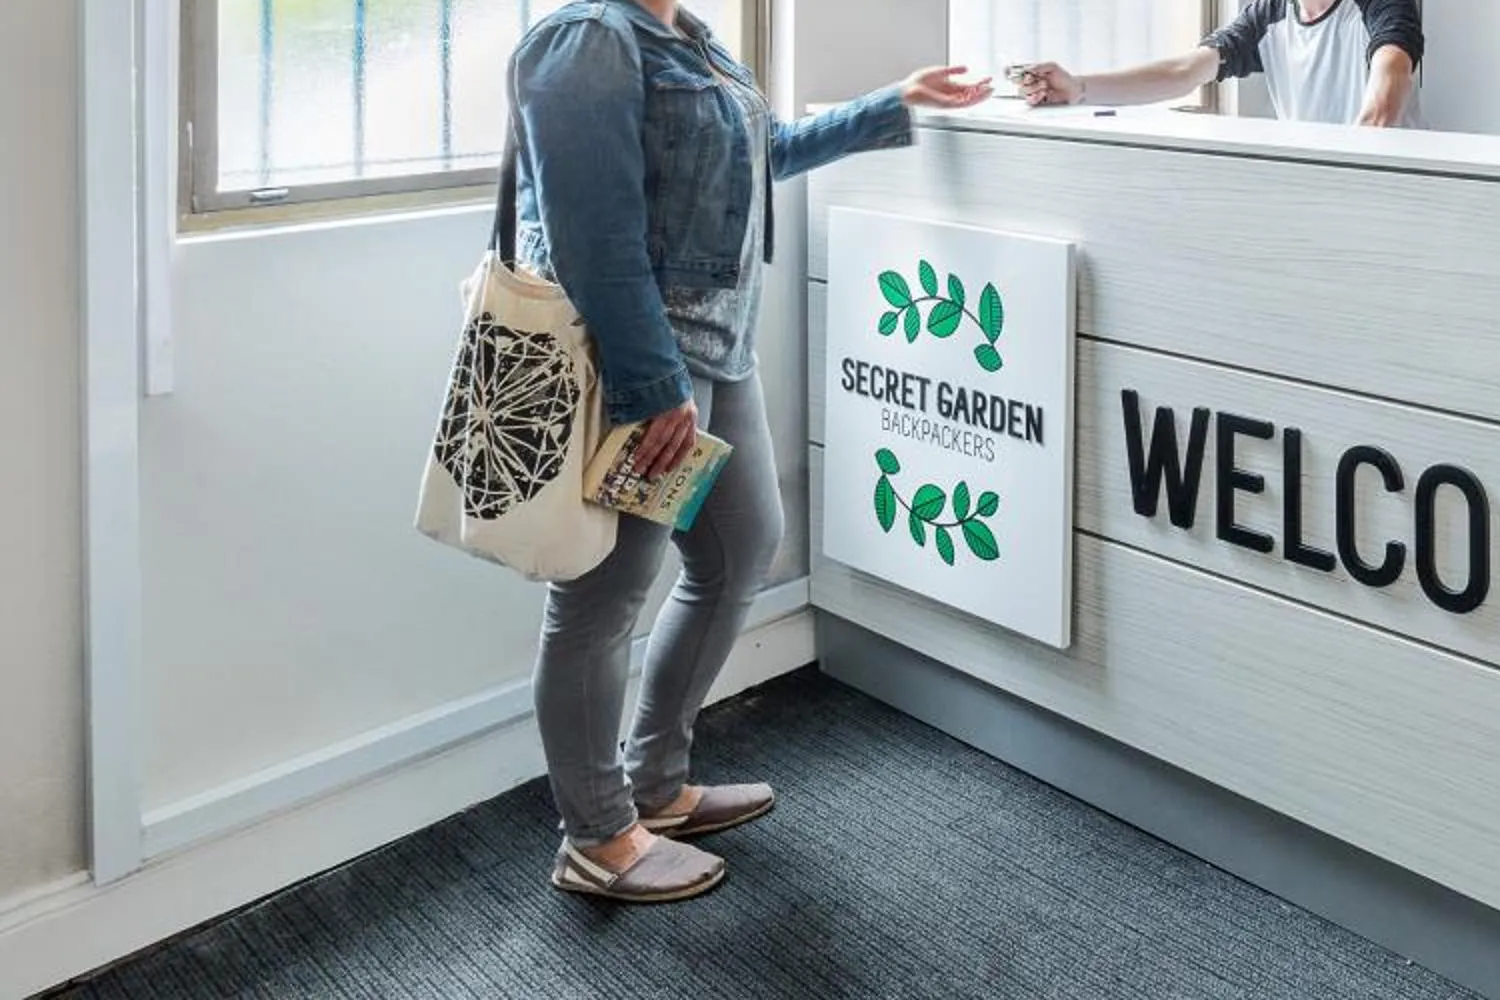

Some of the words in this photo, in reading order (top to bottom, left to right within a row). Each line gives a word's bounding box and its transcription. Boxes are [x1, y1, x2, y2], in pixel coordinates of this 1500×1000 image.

[841, 358, 931, 411] SECRET
[937, 382, 1045, 445] GARDEN
[881, 408, 995, 461] BACKPACKERS
